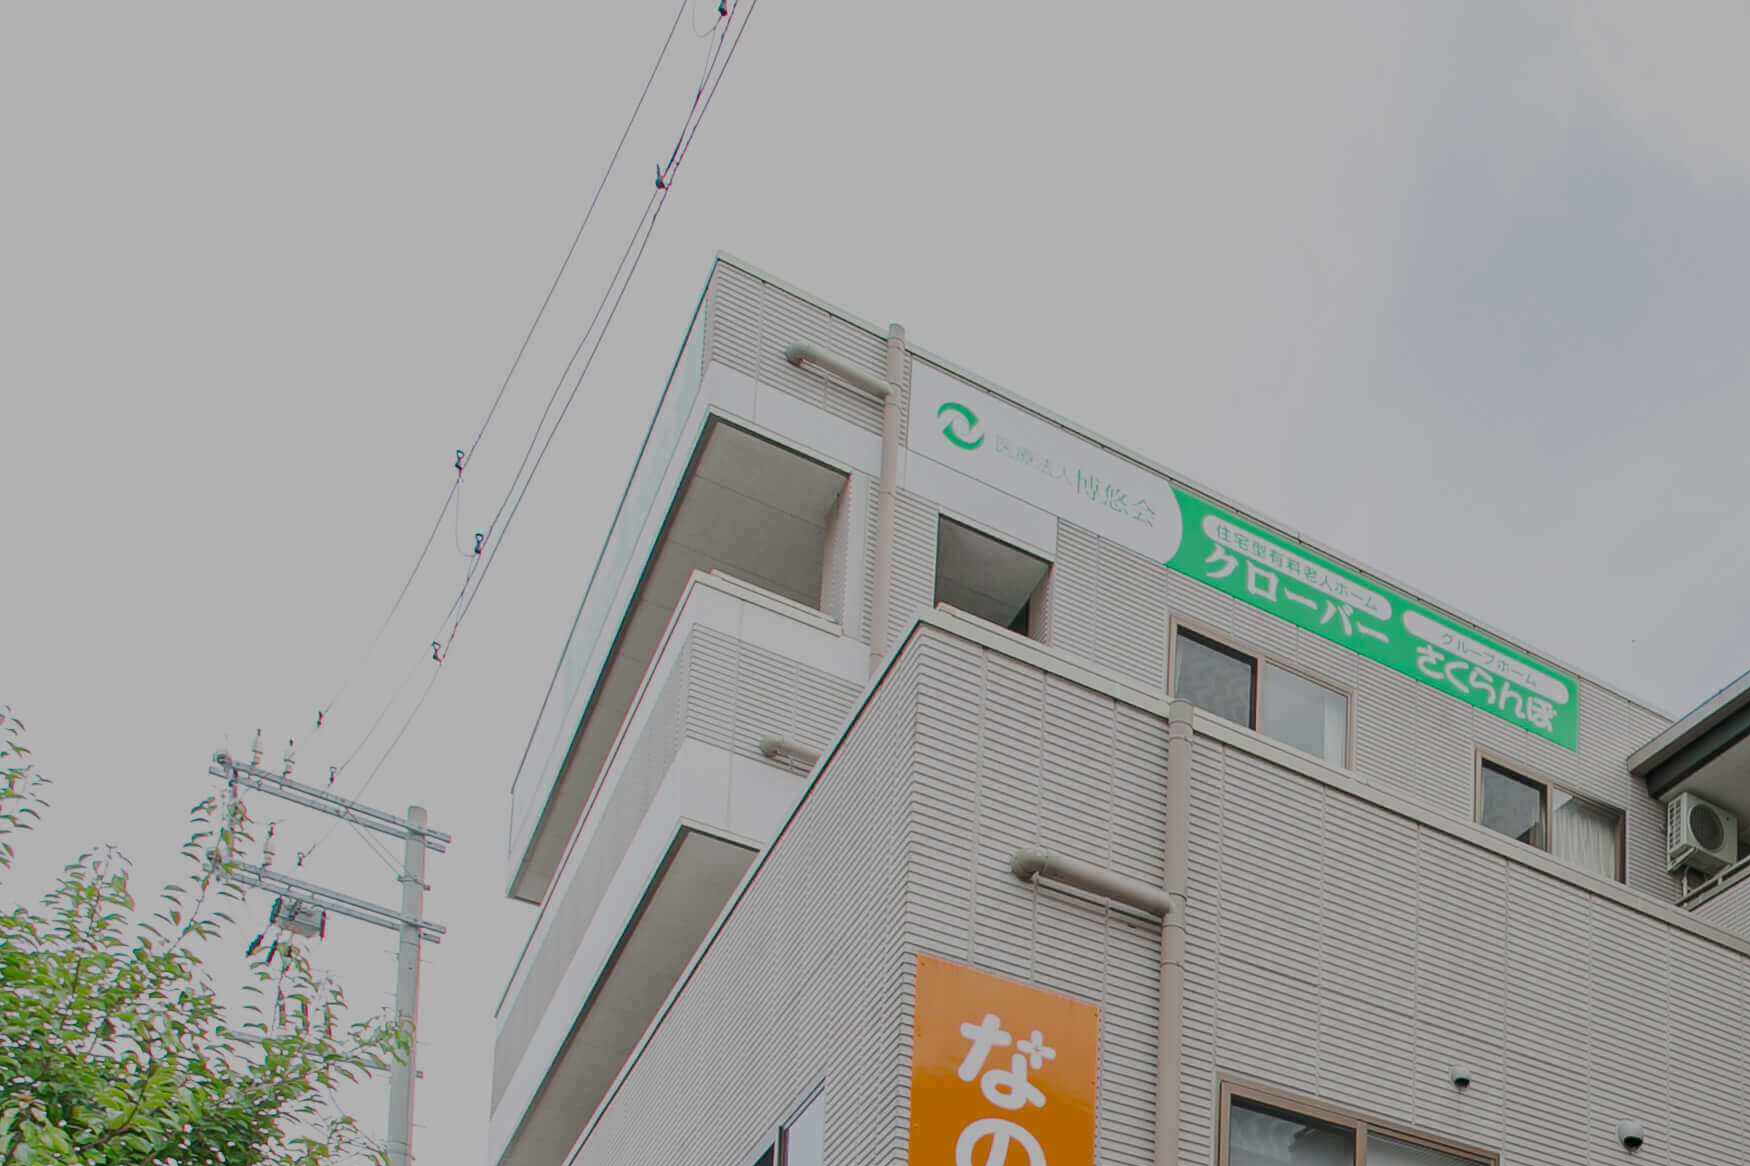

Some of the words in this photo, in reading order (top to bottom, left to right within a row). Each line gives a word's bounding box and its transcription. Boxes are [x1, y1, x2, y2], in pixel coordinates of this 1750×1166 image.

[1204, 543, 1390, 644] クローバー
[1215, 522, 1378, 610] 住宅型有料老人ホーム
[1415, 644, 1557, 733] さくらんぼ
[1441, 632, 1537, 688] グループホーム
